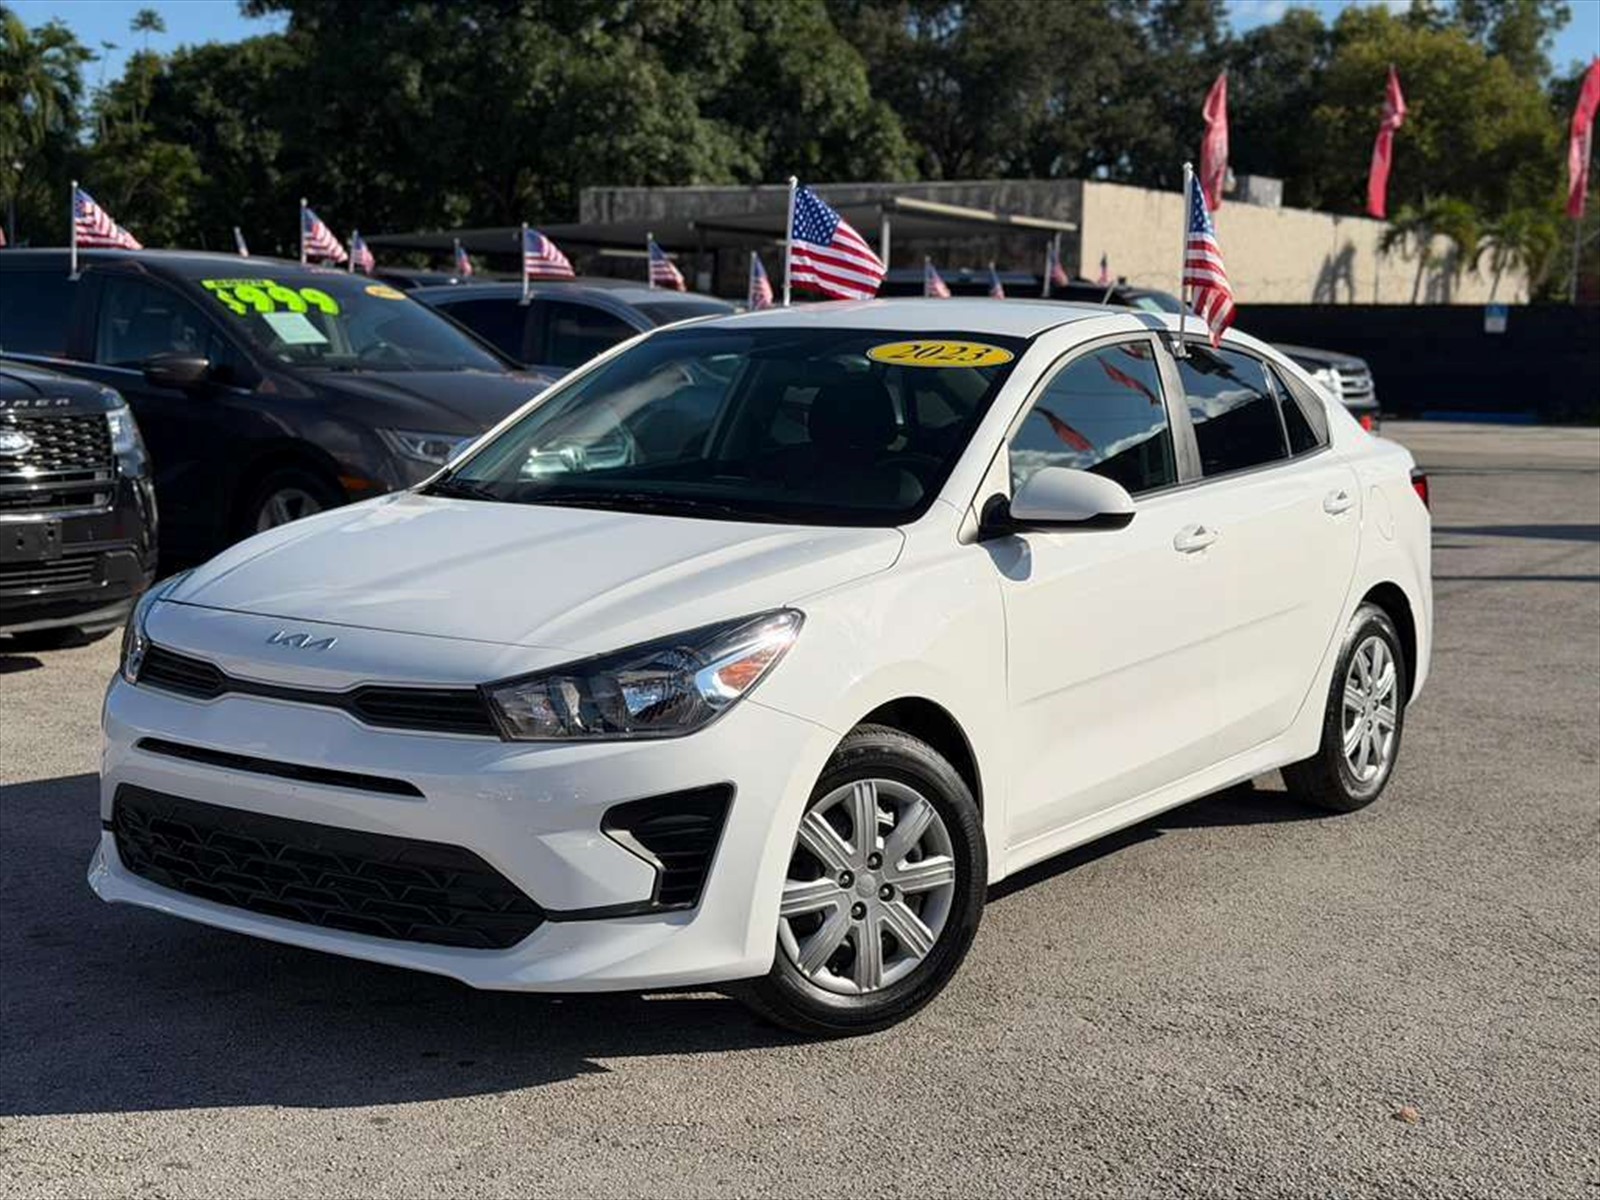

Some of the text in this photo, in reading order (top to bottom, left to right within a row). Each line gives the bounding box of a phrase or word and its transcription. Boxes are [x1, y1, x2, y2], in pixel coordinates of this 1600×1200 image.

[216, 285, 340, 315] $999
[887, 344, 993, 362] 2023
[265, 630, 339, 651] KIA
